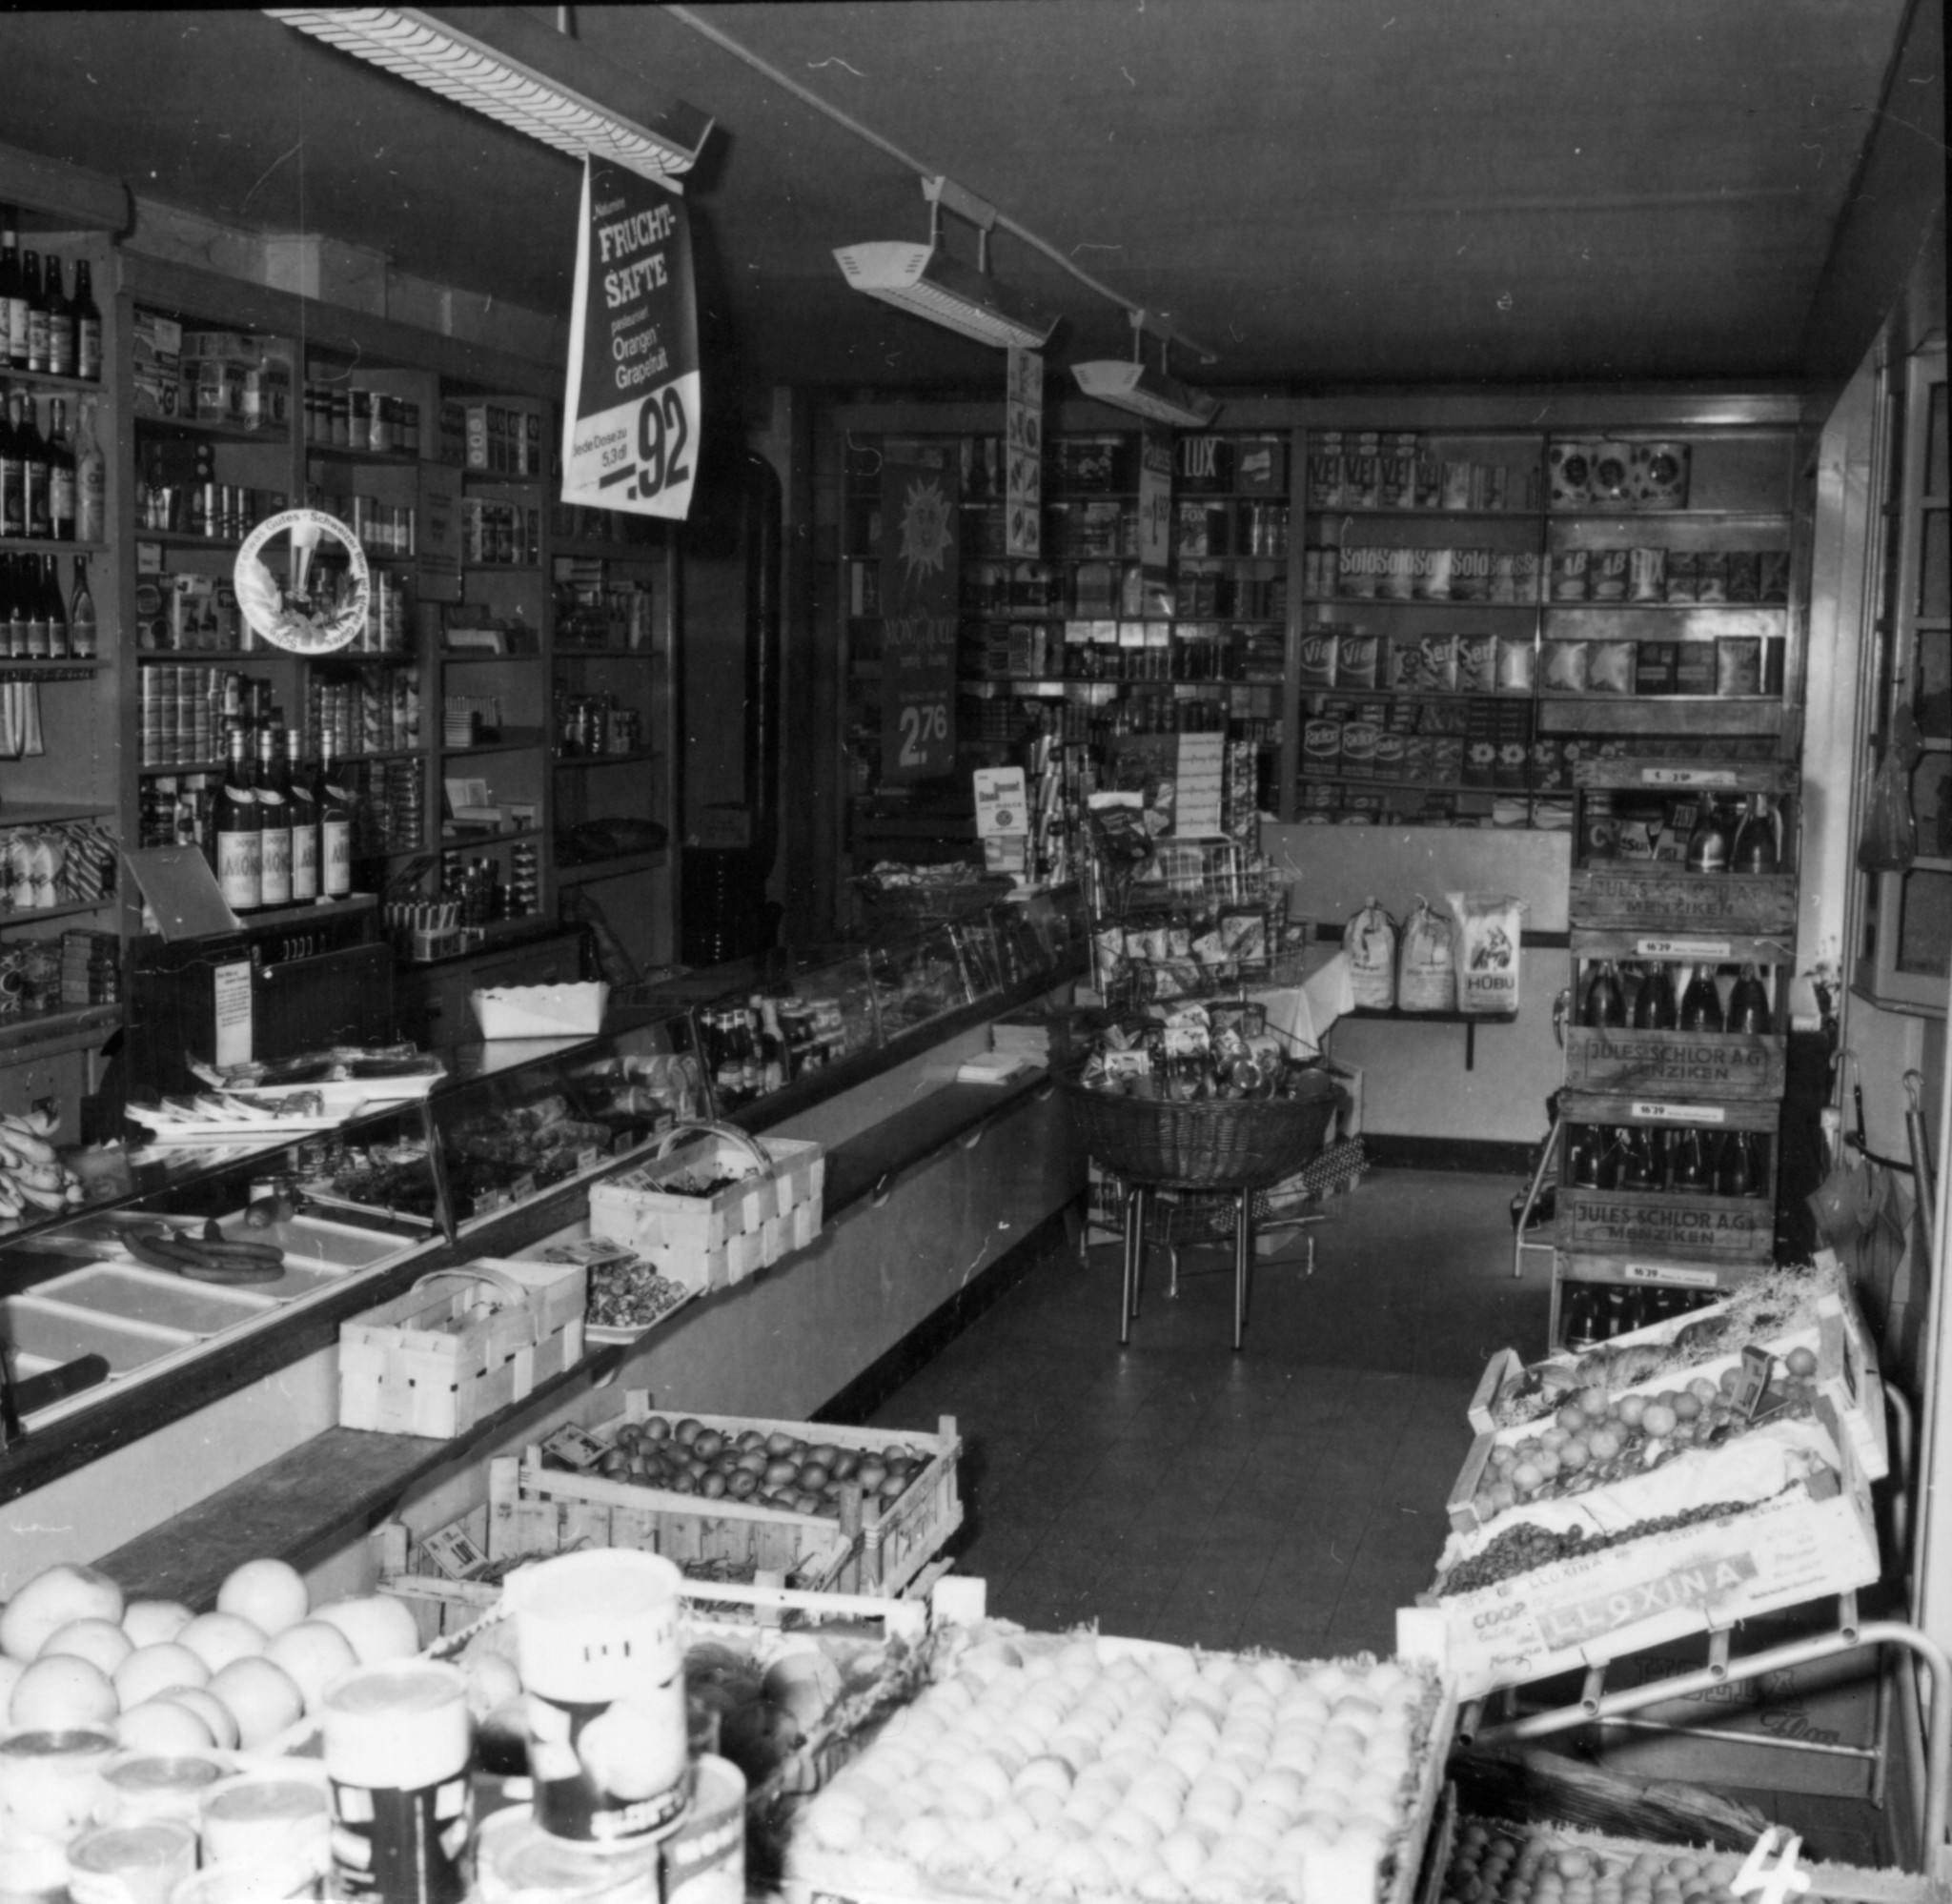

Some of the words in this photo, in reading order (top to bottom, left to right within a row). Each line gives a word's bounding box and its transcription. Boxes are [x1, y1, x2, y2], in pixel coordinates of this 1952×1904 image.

[598, 202, 678, 264] FRUCHT-
[613, 327, 658, 362] Orangen
[615, 346, 669, 390] Grapefruit
[593, 430, 616, 450] Dose
[616, 427, 628, 441] zu
[1184, 437, 1217, 478] LUX
[1180, 509, 1208, 522] FOX
[310, 511, 358, 550] Schweizer
[355, 551, 369, 575] Bier
[1339, 549, 1374, 575] Solo
[1374, 550, 1412, 575] Solo
[1450, 550, 1488, 577] Solo
[1302, 639, 1328, 665] Via
[1341, 640, 1371, 666] Via
[1418, 636, 1457, 672] Serf
[1456, 636, 1496, 673] Serf
[899, 703, 948, 768] 2.76
[1304, 728, 1340, 749] Radion
[1342, 731, 1378, 753] Radion
[1623, 900, 1733, 919] MENZIKEN
[1590, 1043, 1647, 1064] JULES
[1653, 1047, 1729, 1066] SCHLOR
[1577, 1206, 1633, 1228] JULES
[1637, 1209, 1717, 1230] SCHLOR
[1607, 1226, 1716, 1247] MENZIKEN
[1528, 1557, 1606, 1590] LLOXINA
[1550, 1561, 1742, 1637] LLOXINA
[1472, 1601, 1528, 1631] COOP
